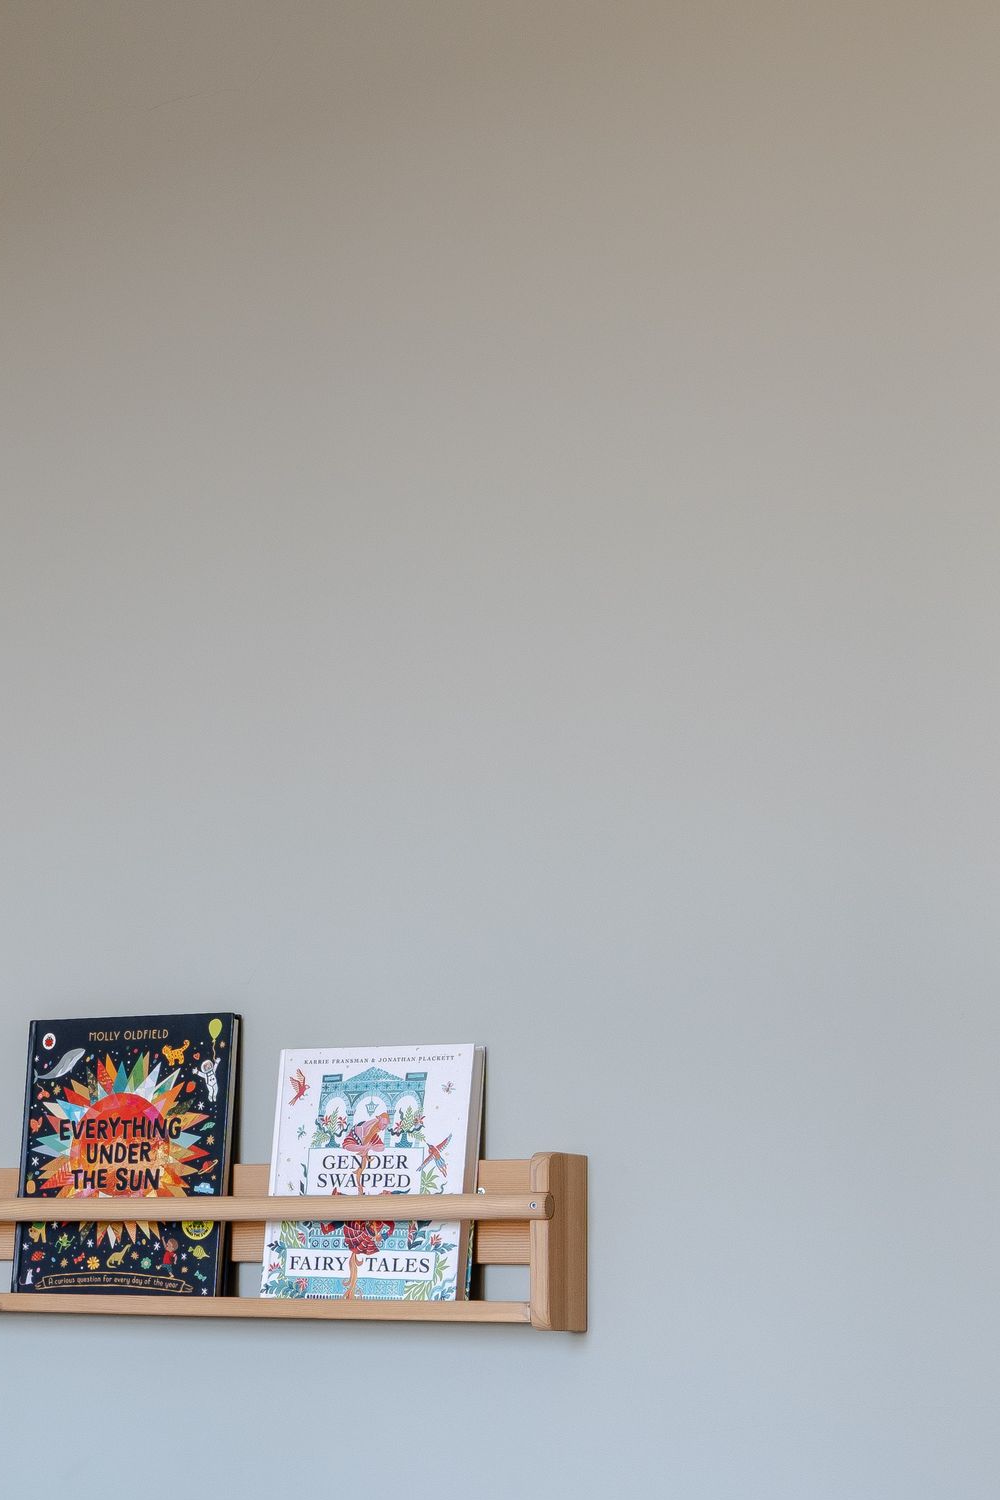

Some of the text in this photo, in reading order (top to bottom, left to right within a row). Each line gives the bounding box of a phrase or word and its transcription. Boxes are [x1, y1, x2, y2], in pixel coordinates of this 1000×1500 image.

[89, 1029, 169, 1041] MOLLY OLDFIELD
[59, 1116, 182, 1141] EVERYTHING
[86, 1141, 151, 1164] UNDER
[322, 1154, 409, 1170] GENDER
[71, 1167, 160, 1191] THE SUN
[316, 1173, 411, 1188] SWAPPED
[289, 1255, 430, 1273] FAIRY TALES
[48, 1277, 54, 1286] A
[77, 1275, 101, 1284] question
[103, 1274, 112, 1283] for
[113, 1277, 130, 1285] every
[132, 1276, 143, 1286] day
[144, 1277, 152, 1285] of
[153, 1278, 163, 1287] the
[165, 1281, 179, 1289] year
